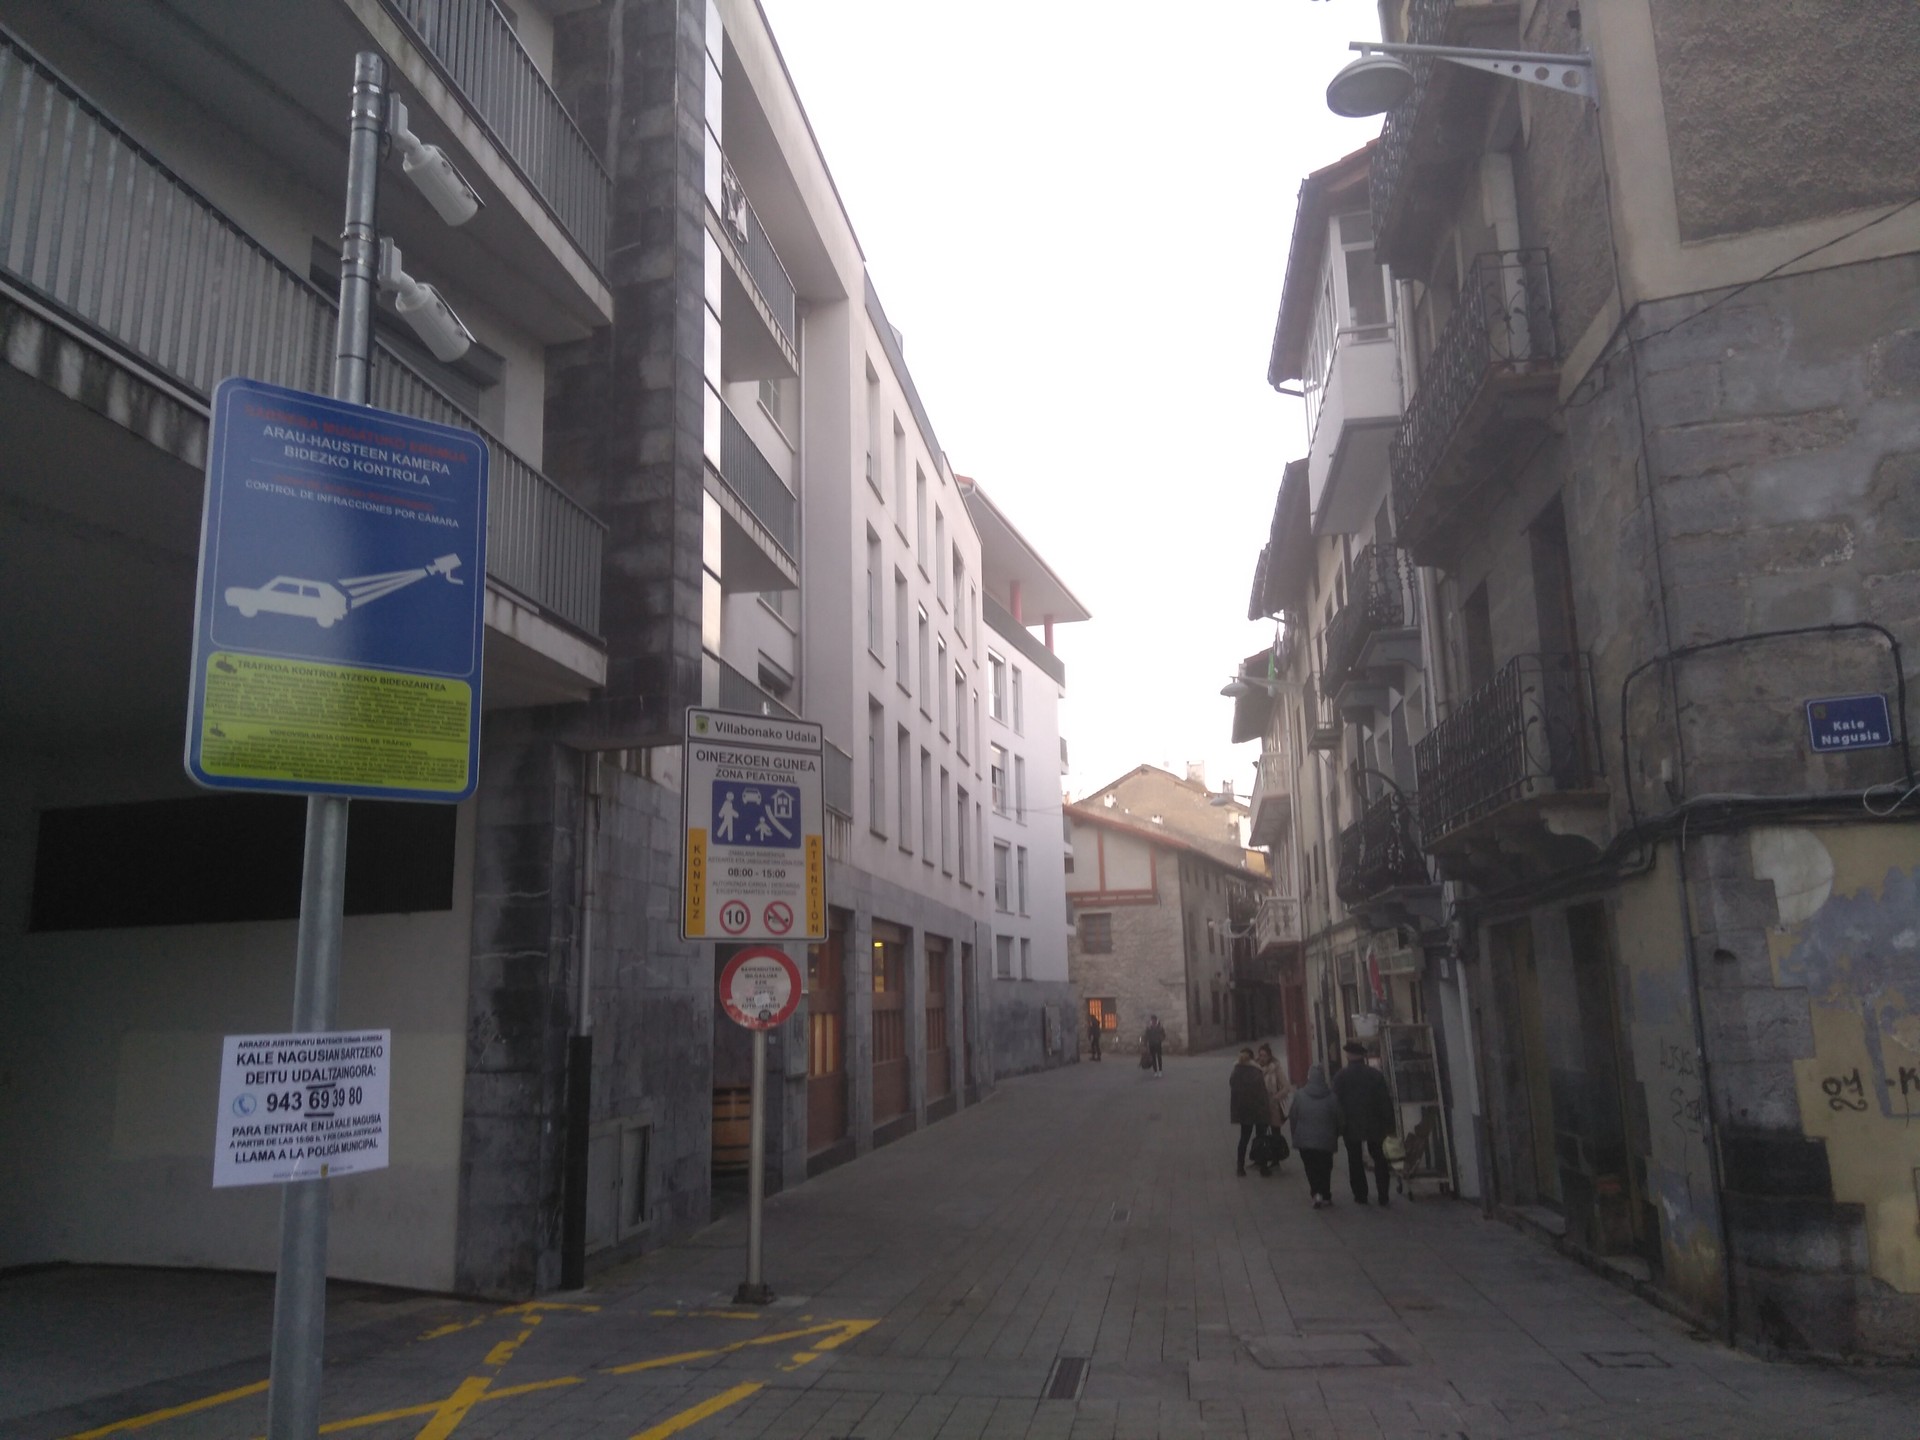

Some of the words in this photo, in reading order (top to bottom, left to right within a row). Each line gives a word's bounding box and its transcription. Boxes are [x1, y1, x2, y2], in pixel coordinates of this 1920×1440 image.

[263, 425, 388, 462] ARAU-HAUSTEEN
[392, 452, 450, 475] KAMERA
[284, 445, 349, 469] BIDEZKO
[353, 460, 431, 486] KONTROLA
[245, 479, 296, 497] CONTROL
[300, 489, 315, 500] DE
[317, 492, 392, 516] INFRACCIONES
[395, 507, 416, 519] POR
[237, 659, 289, 675] TRAFIKOA
[291, 666, 378, 685] KONTROLATZEKO
[379, 677, 447, 692] BIDEOZAINTZA
[715, 721, 783, 740] Villabonako
[785, 730, 817, 744] Udala
[1822, 730, 1880, 745] Nagusia
[696, 749, 770, 768] OINEZKOEN
[773, 758, 816, 773] GUNEA
[715, 769, 744, 780] ZONA
[746, 770, 797, 785] PEATONAL
[692, 844, 702, 920] KONTUZ
[727, 867, 754, 878] 08:00
[762, 868, 786, 879] 15:00
[726, 909, 745, 926] 10
[237, 1052, 274, 1066] KALE
[278, 1048, 339, 1063] NAGUSIAN
[340, 1045, 384, 1060] SARTZEKO
[245, 1070, 288, 1085] DEITU
[291, 1064, 377, 1083] UDALTZAINGORA:
[266, 1092, 302, 1113] 943
[308, 1089, 330, 1110] 69
[332, 1088, 346, 1107] 39
[349, 1086, 363, 1106] 80
[232, 1126, 261, 1138] PARA
[264, 1122, 308, 1135] ENTRAR
[311, 1121, 324, 1132] EN
[334, 1117, 351, 1129] KALE
[352, 1113, 381, 1127] NAGUSIA
[229, 1141, 236, 1149] A
[236, 1139, 265, 1148] PARTIR
[266, 1138, 277, 1146] DE
[279, 1136, 294, 1145] LAS
[235, 1150, 276, 1164] LLAMA
[278, 1149, 287, 1160] A
[289, 1148, 304, 1159] LA
[341, 1138, 379, 1153] MUNICIPAL
